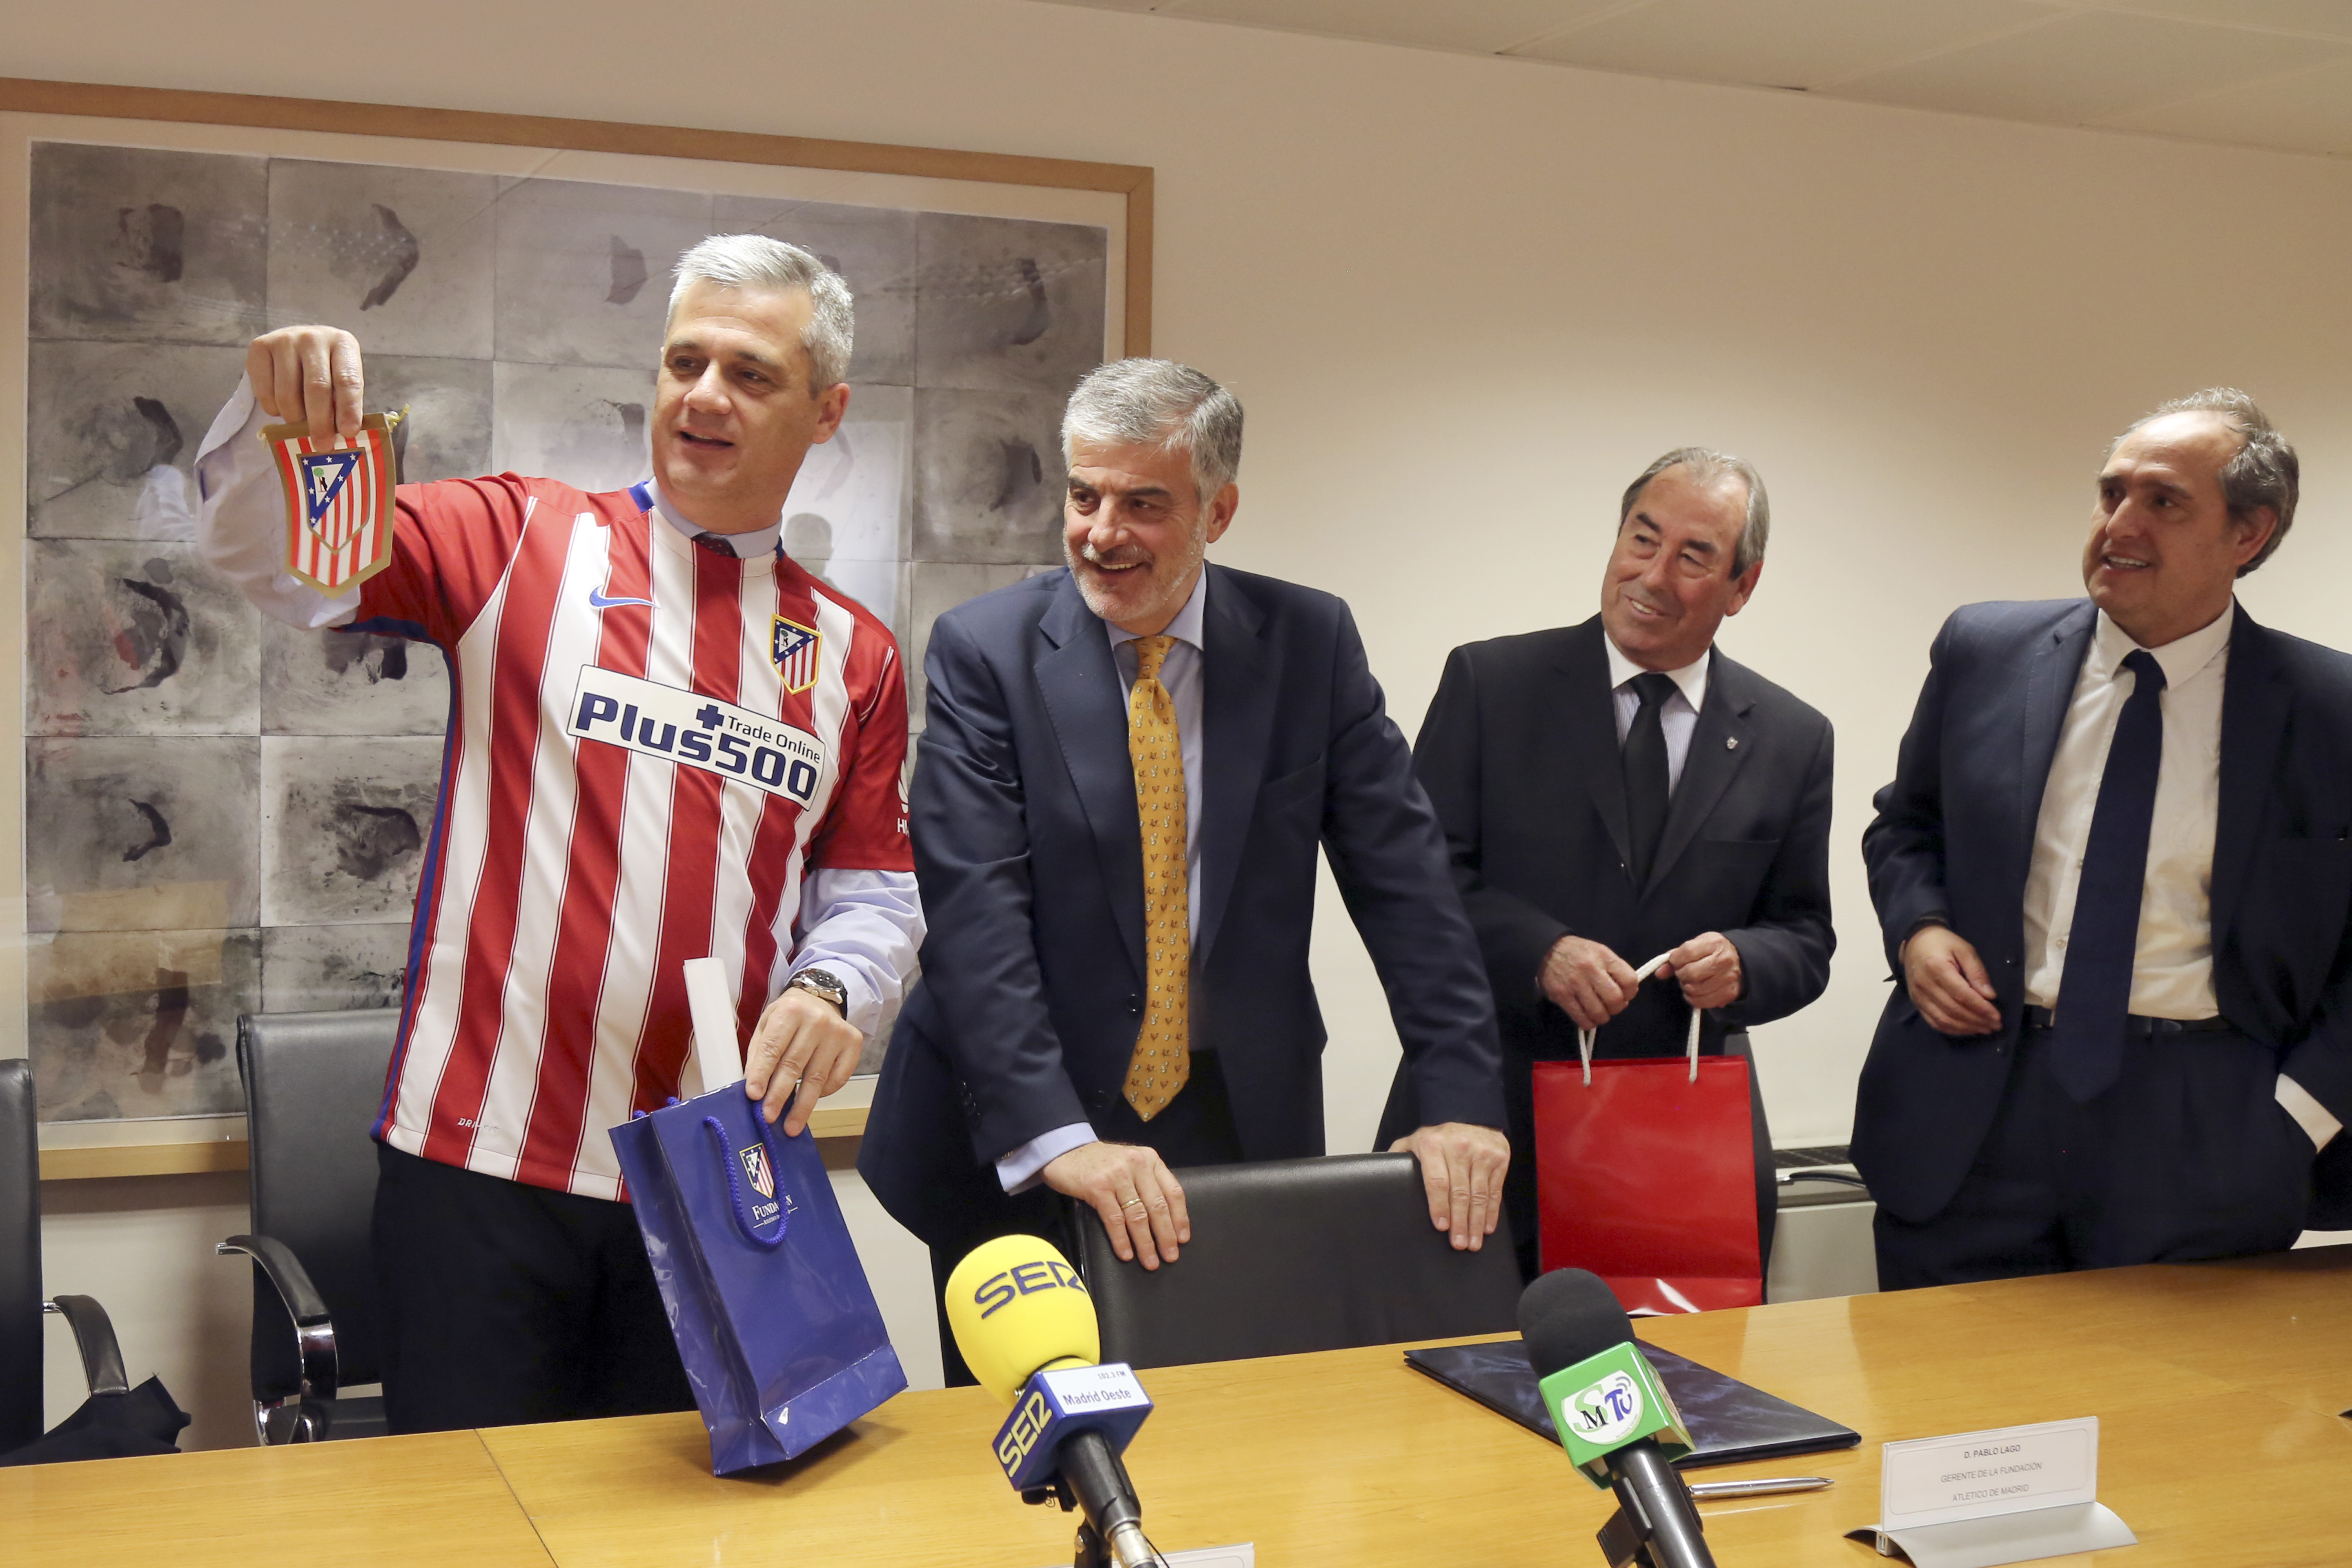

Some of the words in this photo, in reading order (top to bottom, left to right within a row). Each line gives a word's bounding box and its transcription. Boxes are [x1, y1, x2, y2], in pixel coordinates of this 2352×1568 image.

[575, 692, 817, 801] Plus500
[727, 715, 772, 743] Trade
[776, 735, 820, 764] Online
[752, 1195, 793, 1220] FUNDAN
[975, 1261, 1086, 1319] SER
[1062, 1391, 1101, 1406] Madrid
[1101, 1389, 1131, 1401] Oeste
[999, 1391, 1053, 1477] SER
[1973, 1448, 1999, 1457] PABLO
[2000, 1445, 2021, 1454] LAGO
[1941, 1471, 1976, 1483] GERENTE
[1978, 1470, 1988, 1478] DE
[1952, 1490, 1988, 1501] ATLETICO
[1989, 1488, 2000, 1497] DE
[2001, 1484, 2029, 1495] MADRID
